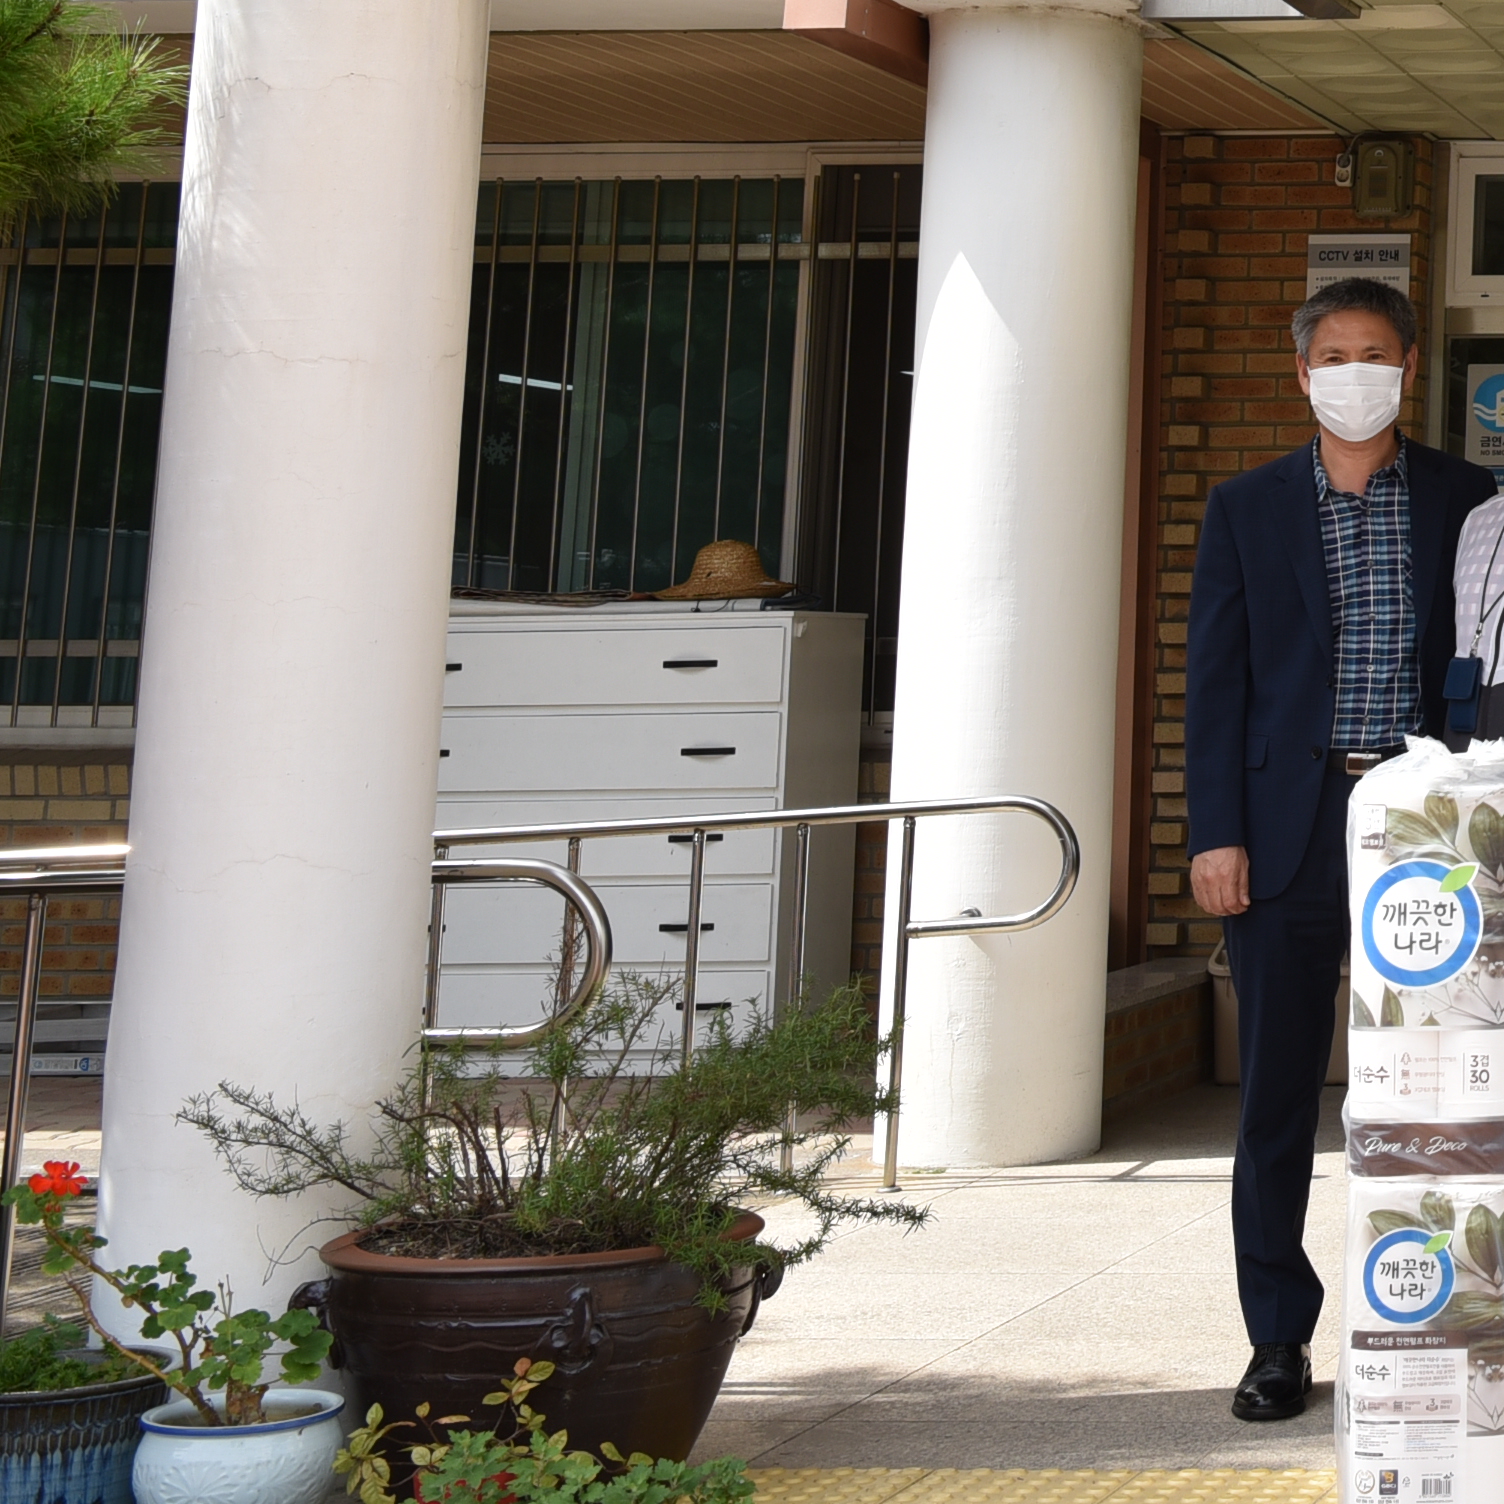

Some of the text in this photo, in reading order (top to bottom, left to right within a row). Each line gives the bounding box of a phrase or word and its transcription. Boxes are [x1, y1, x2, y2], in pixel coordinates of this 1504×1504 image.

[1318, 249, 1400, 262] CCTV 설치 안내
[1381, 899, 1457, 927] 깨끗한
[1394, 931, 1443, 955] 나라
[1469, 1054, 1490, 1067] 3겹
[1353, 1065, 1390, 1084] 더순수
[1469, 1069, 1490, 1084] 30
[1363, 1136, 1468, 1157] Pure & Deco
[1379, 1258, 1437, 1280] 깨끗한
[1389, 1282, 1426, 1300] 나라
[1366, 1336, 1446, 1346] 부드러운 천연펄프 화장지
[1355, 1364, 1391, 1382] 더순수
